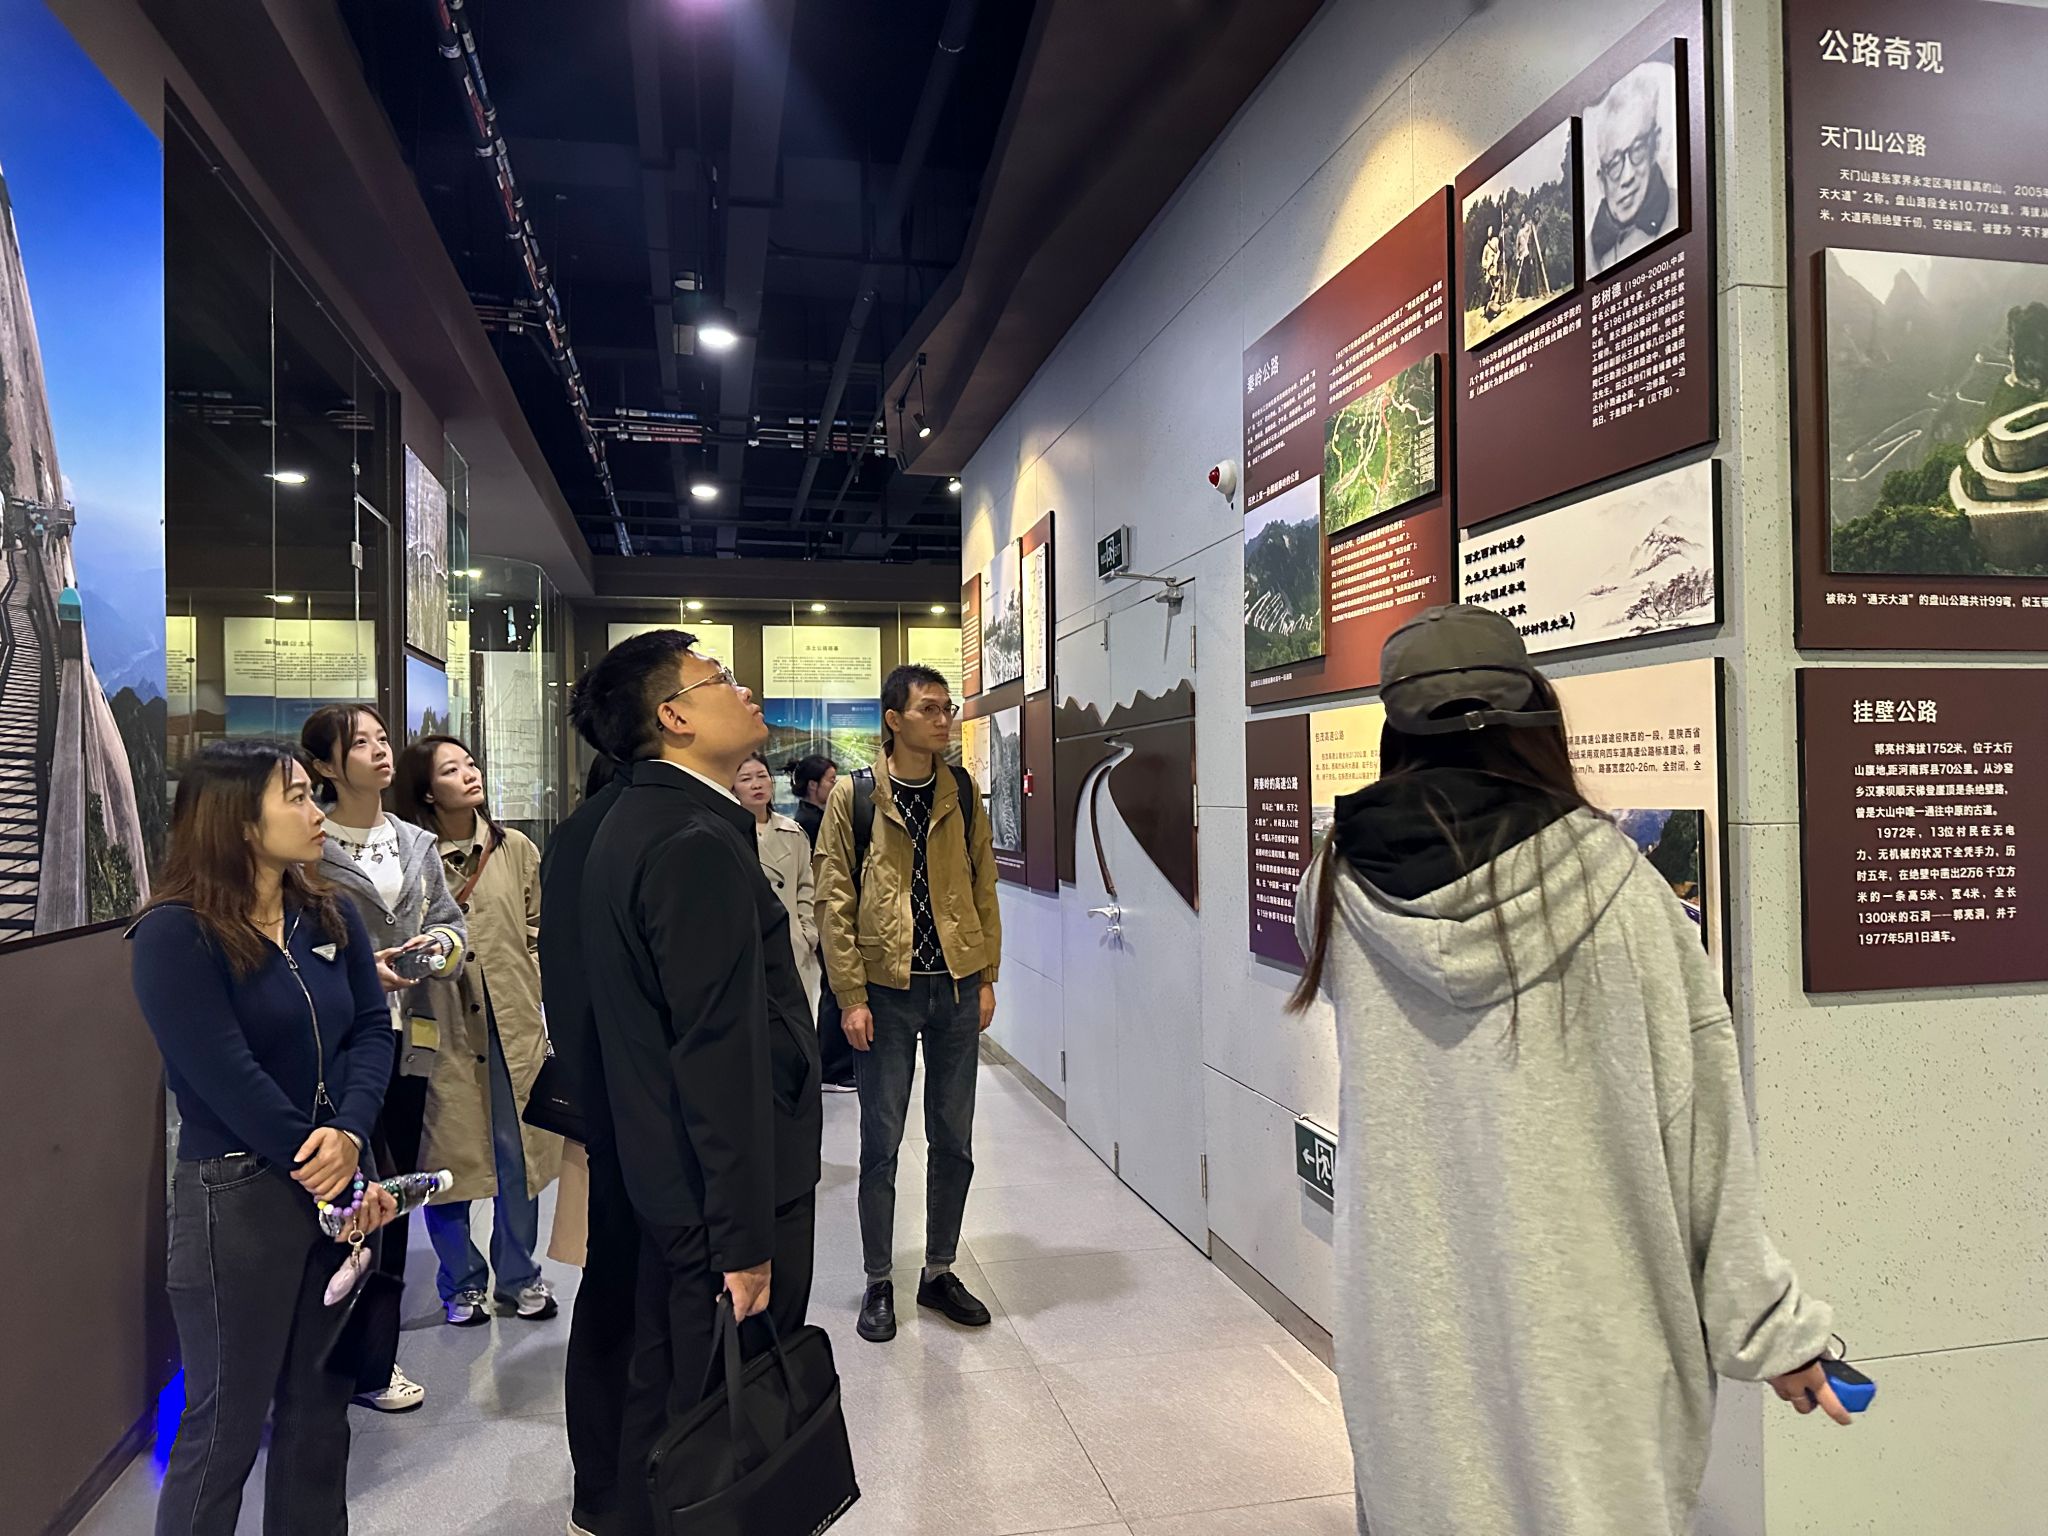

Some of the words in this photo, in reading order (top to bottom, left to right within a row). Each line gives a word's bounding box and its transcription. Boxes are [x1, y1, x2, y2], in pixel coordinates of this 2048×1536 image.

[1819, 29, 1944, 74] 公路奇观
[1820, 125, 1926, 157] 天门山公路
[1591, 281, 1621, 311] 彭树德
[1853, 700, 1938, 723] 挂壁公路
[1874, 742, 2014, 756] 郭亮村海拔1752米，位于太行
[1253, 775, 1299, 791] 跨秦岭的高速公路
[1855, 804, 1999, 819] 曾是大山中唯一通往中原的古道。
[1877, 824, 2016, 839] 1972年，13位村民在无电
[1858, 930, 1957, 946] 1977年5月1日通车。
